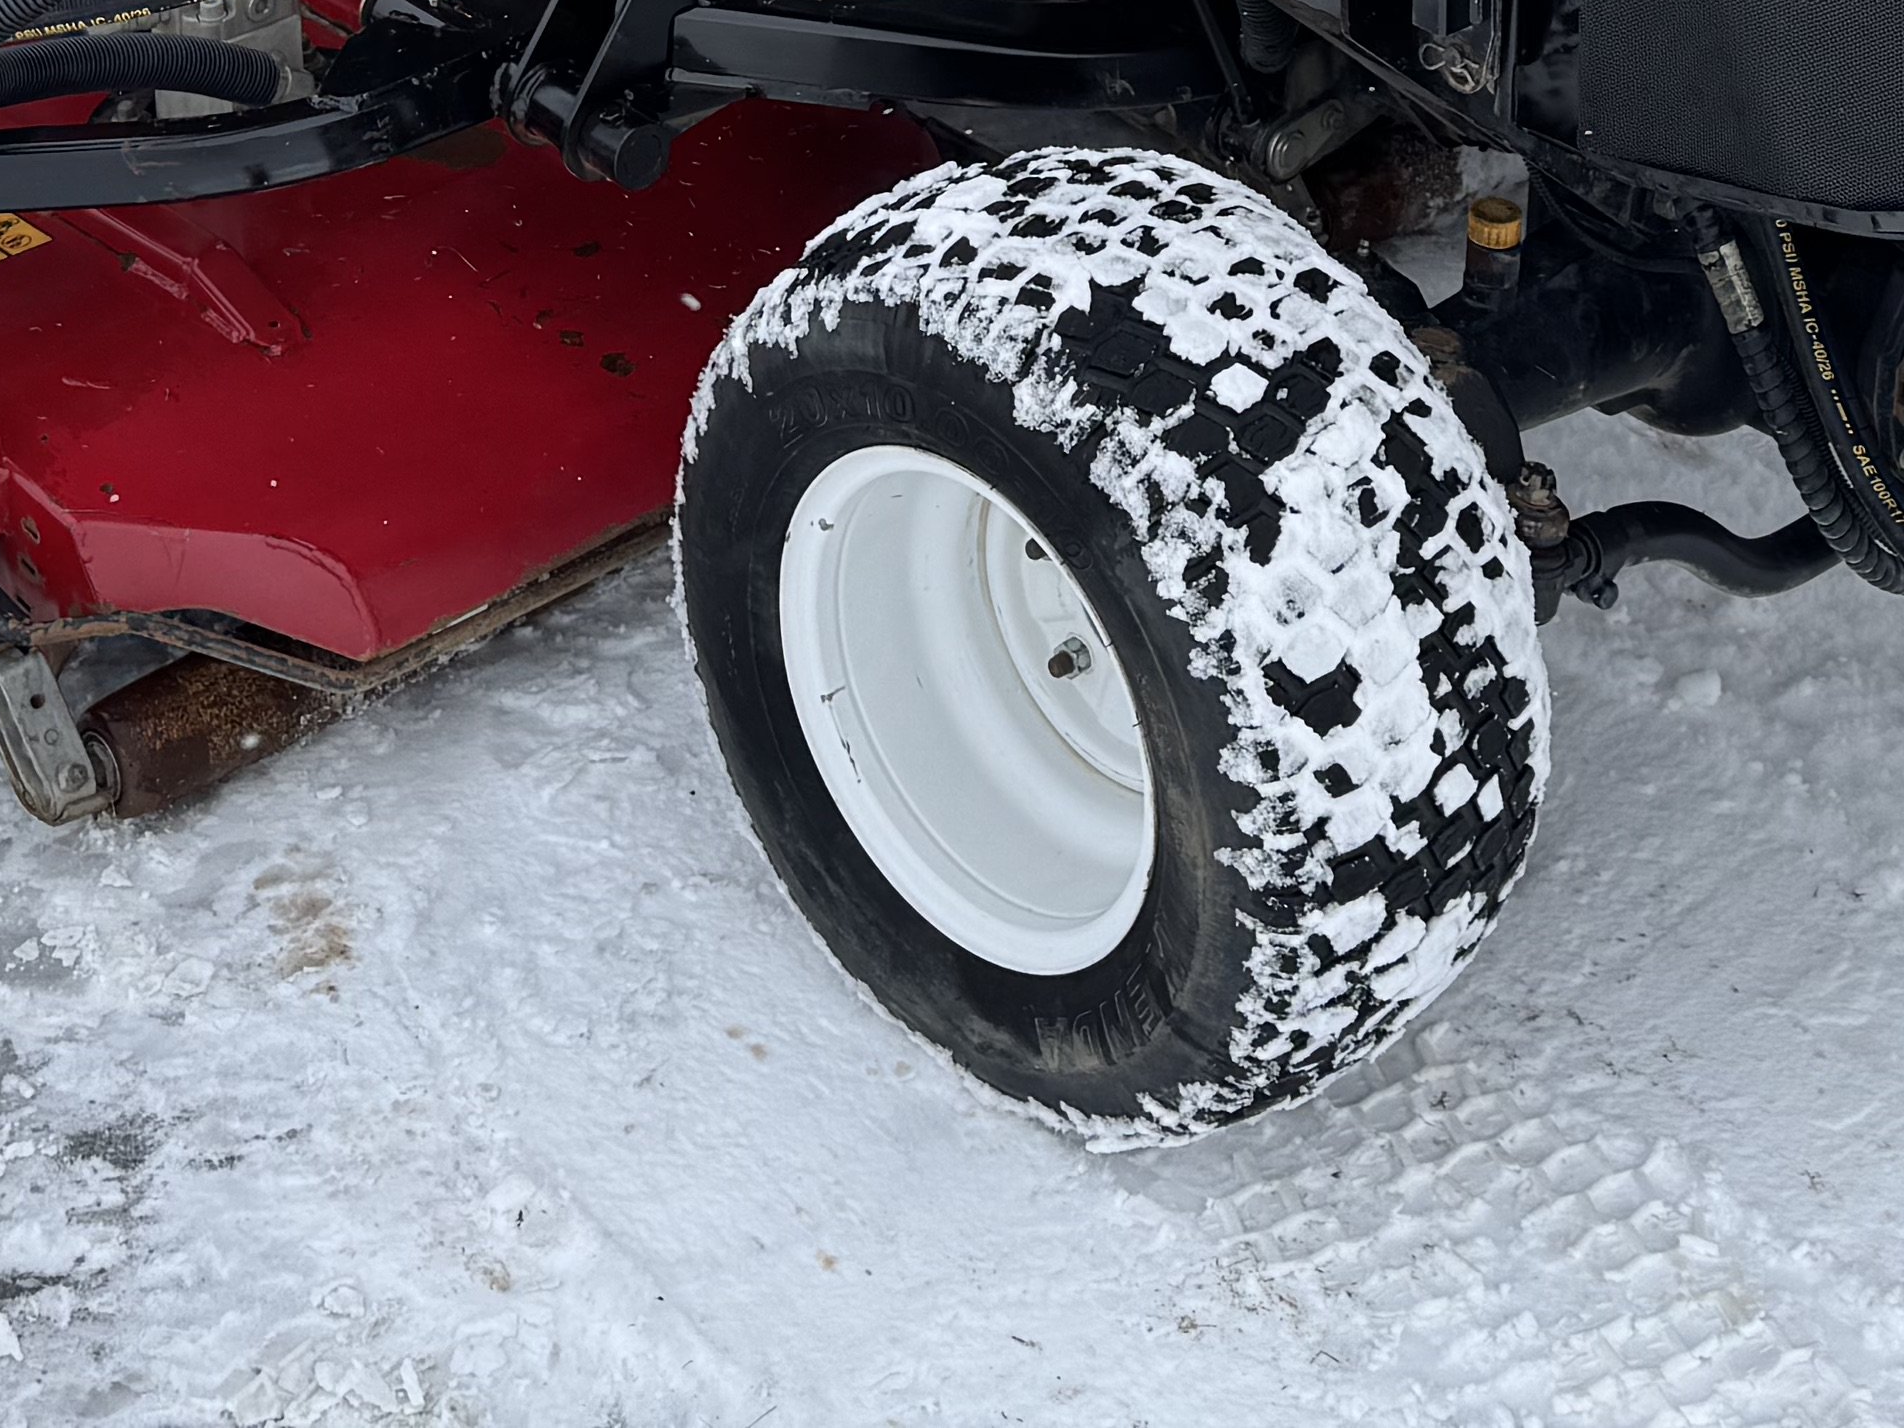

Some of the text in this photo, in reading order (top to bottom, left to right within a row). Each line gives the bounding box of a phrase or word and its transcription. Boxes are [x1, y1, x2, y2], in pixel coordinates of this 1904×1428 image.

[1779, 232, 1799, 263] PSI)
[1789, 266, 1813, 314] MSHA
[1803, 318, 1835, 381] IC-40/26
